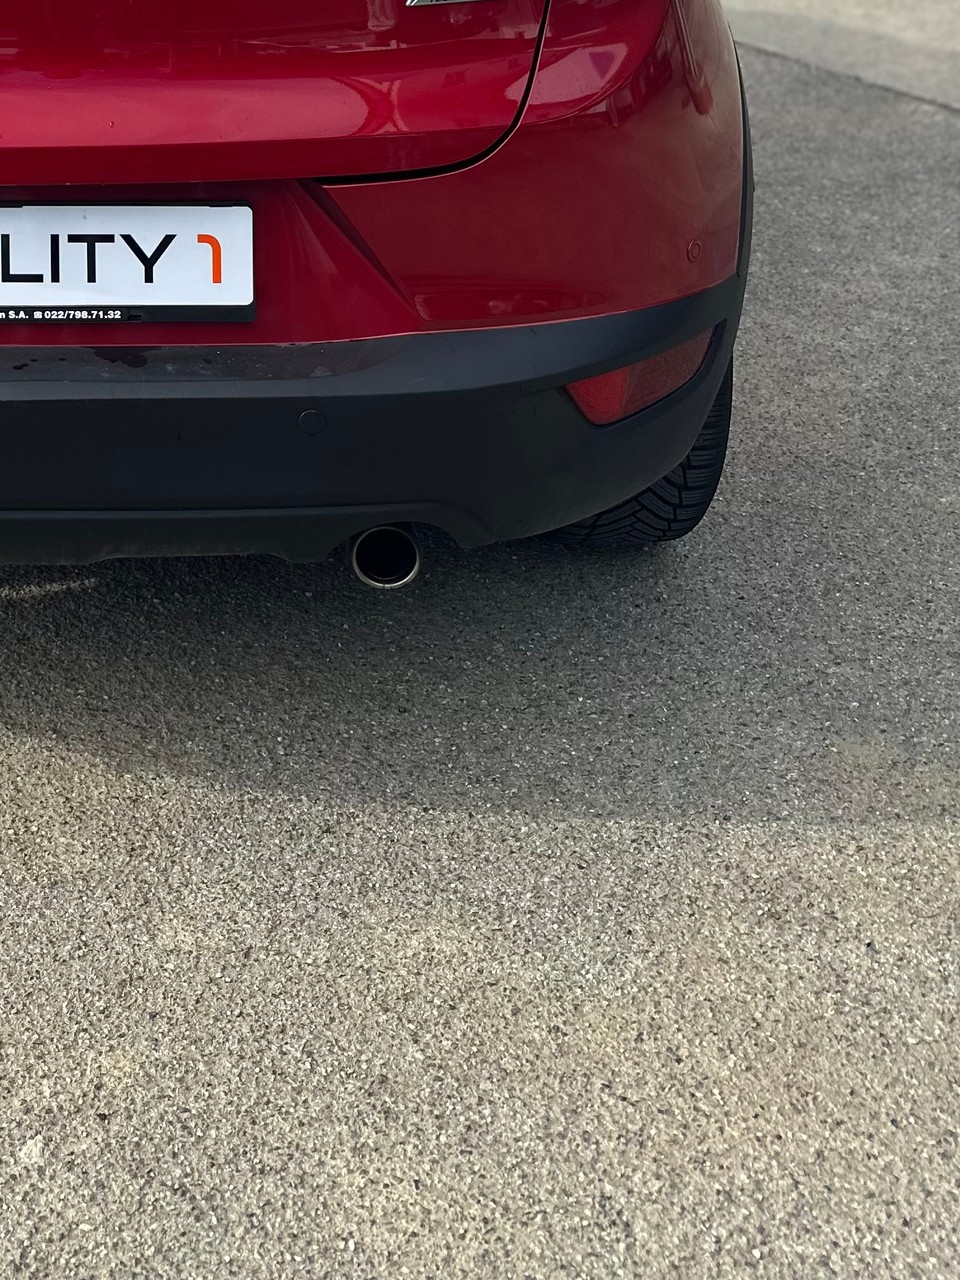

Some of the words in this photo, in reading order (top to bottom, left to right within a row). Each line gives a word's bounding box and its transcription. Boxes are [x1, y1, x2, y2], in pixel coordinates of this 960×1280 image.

[197, 233, 222, 284] 1
[8, 310, 29, 319] S.A.
[44, 310, 122, 319] 022/798.71.32
